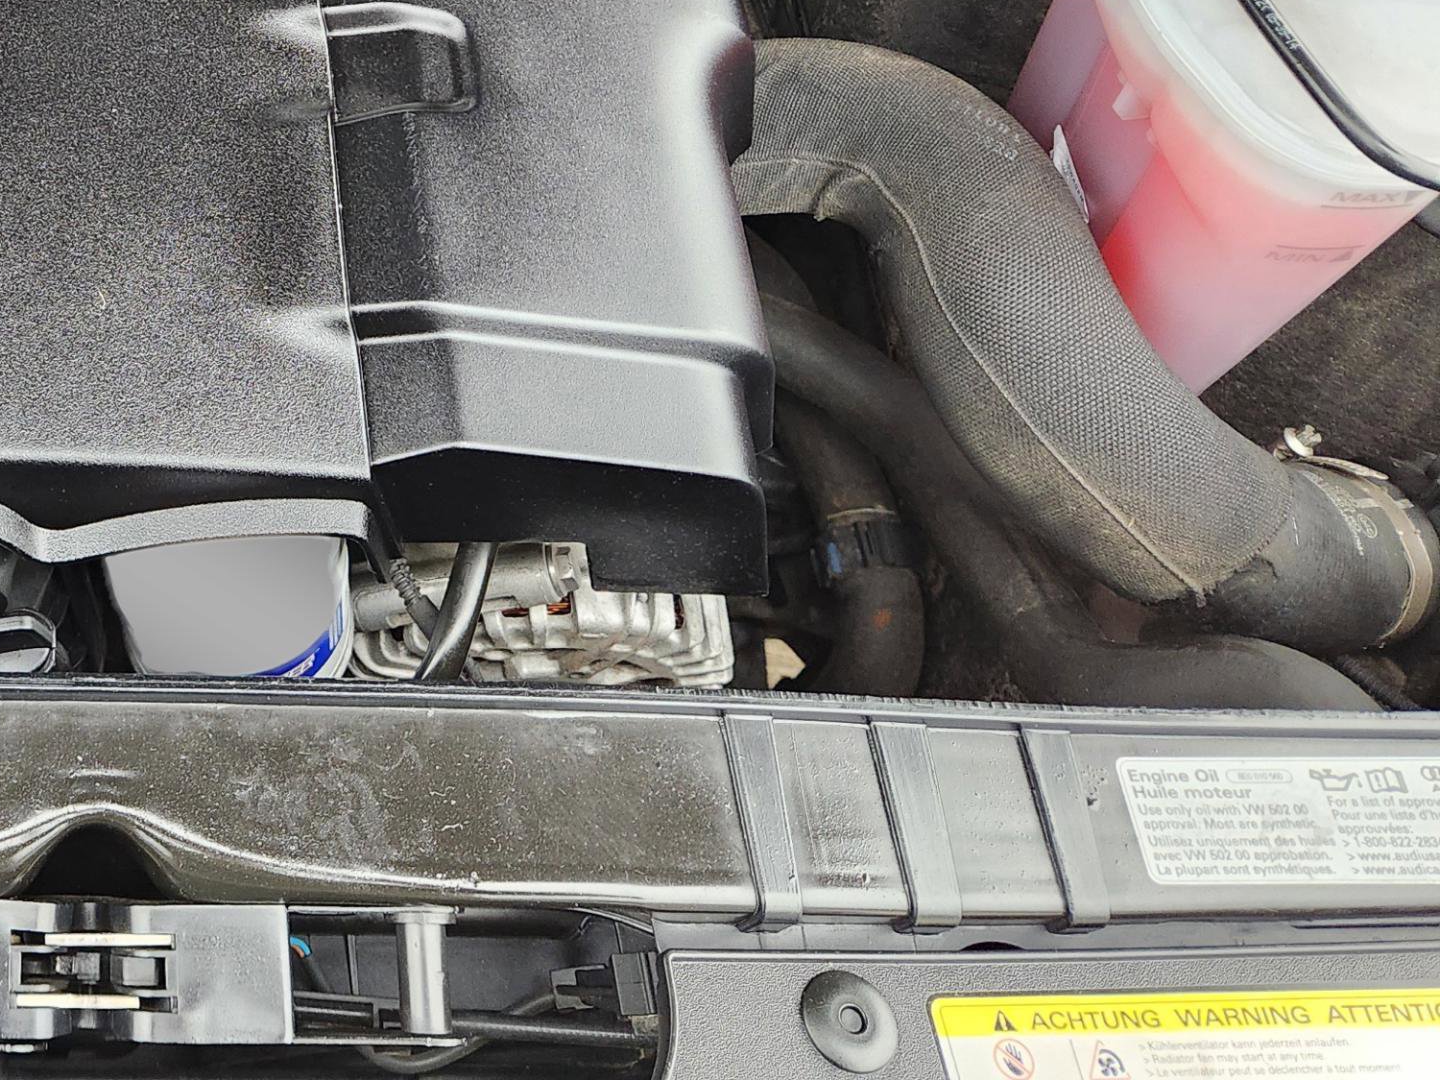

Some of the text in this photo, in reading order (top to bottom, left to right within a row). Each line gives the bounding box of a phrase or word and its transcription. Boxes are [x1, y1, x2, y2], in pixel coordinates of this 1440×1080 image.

[1329, 191, 1398, 203] MAX
[1264, 251, 1326, 263] MIN
[1127, 768, 1189, 786] Engine
[1194, 768, 1220, 783] Oil
[1132, 785, 1251, 799] Huile moteur
[1327, 796, 1347, 807] For
[1352, 799, 1359, 807] a
[1360, 795, 1381, 807] list
[1383, 795, 1395, 807] of
[1137, 803, 1309, 817] Use only oil with VW 502 00
[1332, 809, 1360, 820] Pour
[1364, 812, 1388, 820] une
[1389, 809, 1416, 820] liste
[1203, 818, 1236, 829] Most
[1239, 821, 1259, 829] are
[1147, 835, 1337, 851] Utilisez uniquement des huiles
[1153, 852, 1182, 861] avec
[1183, 849, 1207, 861] VW
[1209, 849, 1232, 861] 502
[1234, 849, 1250, 861] 00
[1157, 864, 1172, 876] La
[1175, 864, 1221, 877] plupart
[1223, 864, 1250, 875] sont
[1031, 1009, 1161, 1031] ACHTUNG
[1174, 1005, 1312, 1028] WARNING
[1231, 1038, 1257, 1049] kann
[1151, 1054, 1194, 1064] Radiator
[1197, 1053, 1215, 1063] fan
[1217, 1053, 1239, 1063] may
[1241, 1052, 1265, 1062] start
[1267, 1052, 1278, 1061] at
[1280, 1052, 1298, 1062] any
